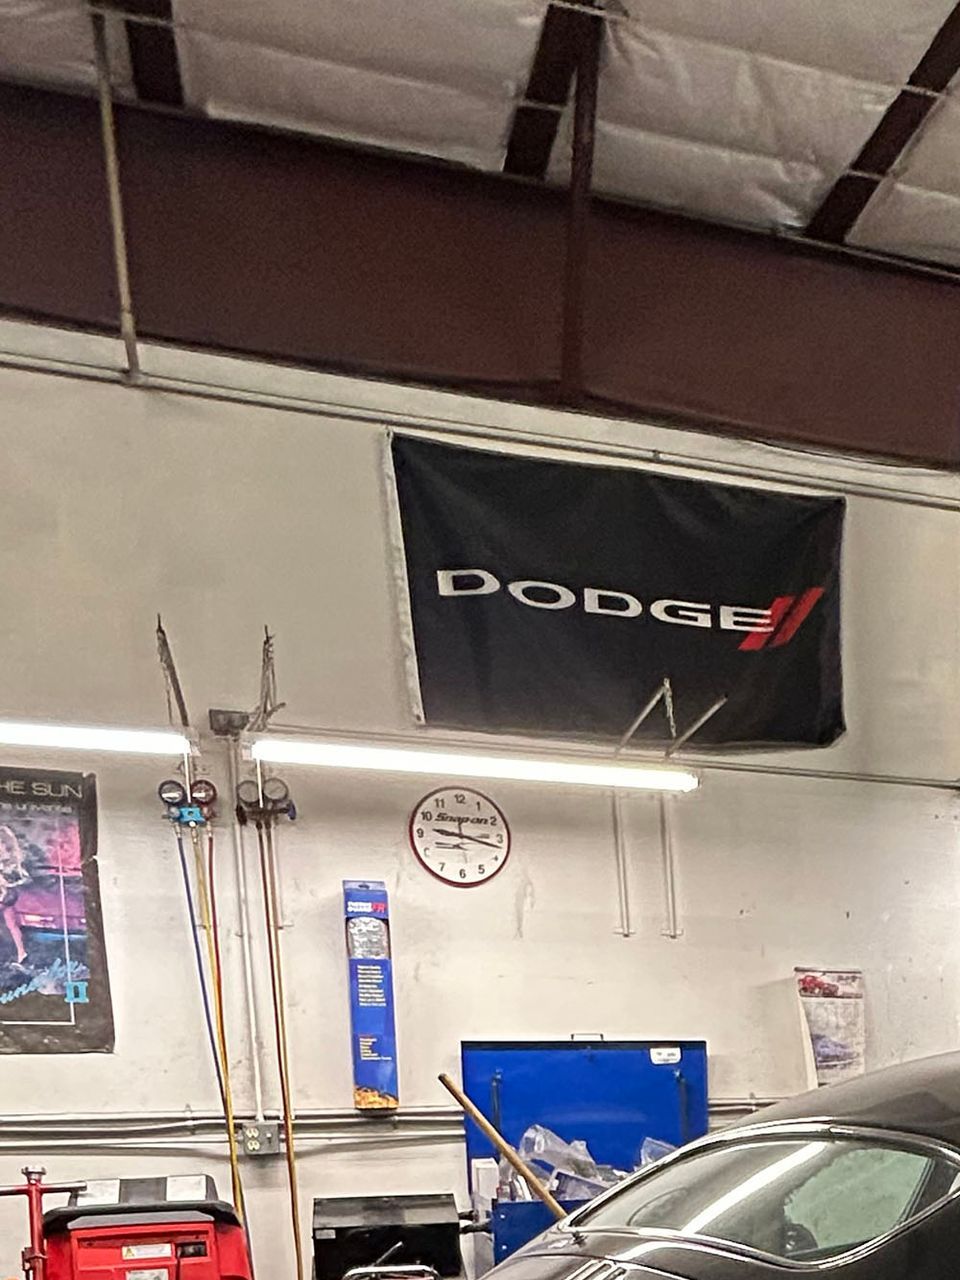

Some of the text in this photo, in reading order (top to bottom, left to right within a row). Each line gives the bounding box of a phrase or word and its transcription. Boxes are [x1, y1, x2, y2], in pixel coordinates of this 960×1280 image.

[437, 568, 774, 634] DODGE
[31, 782, 83, 798] SUN
[434, 798, 445, 809] 11
[454, 793, 466, 805] 12
[476, 801, 481, 811] 1
[421, 811, 433, 822] 10
[490, 815, 497, 826] 2
[416, 827, 424, 838] 9
[496, 833, 504, 844] 3
[439, 862, 446, 872] 7
[478, 864, 485, 875] 5
[459, 868, 467, 879] 6
